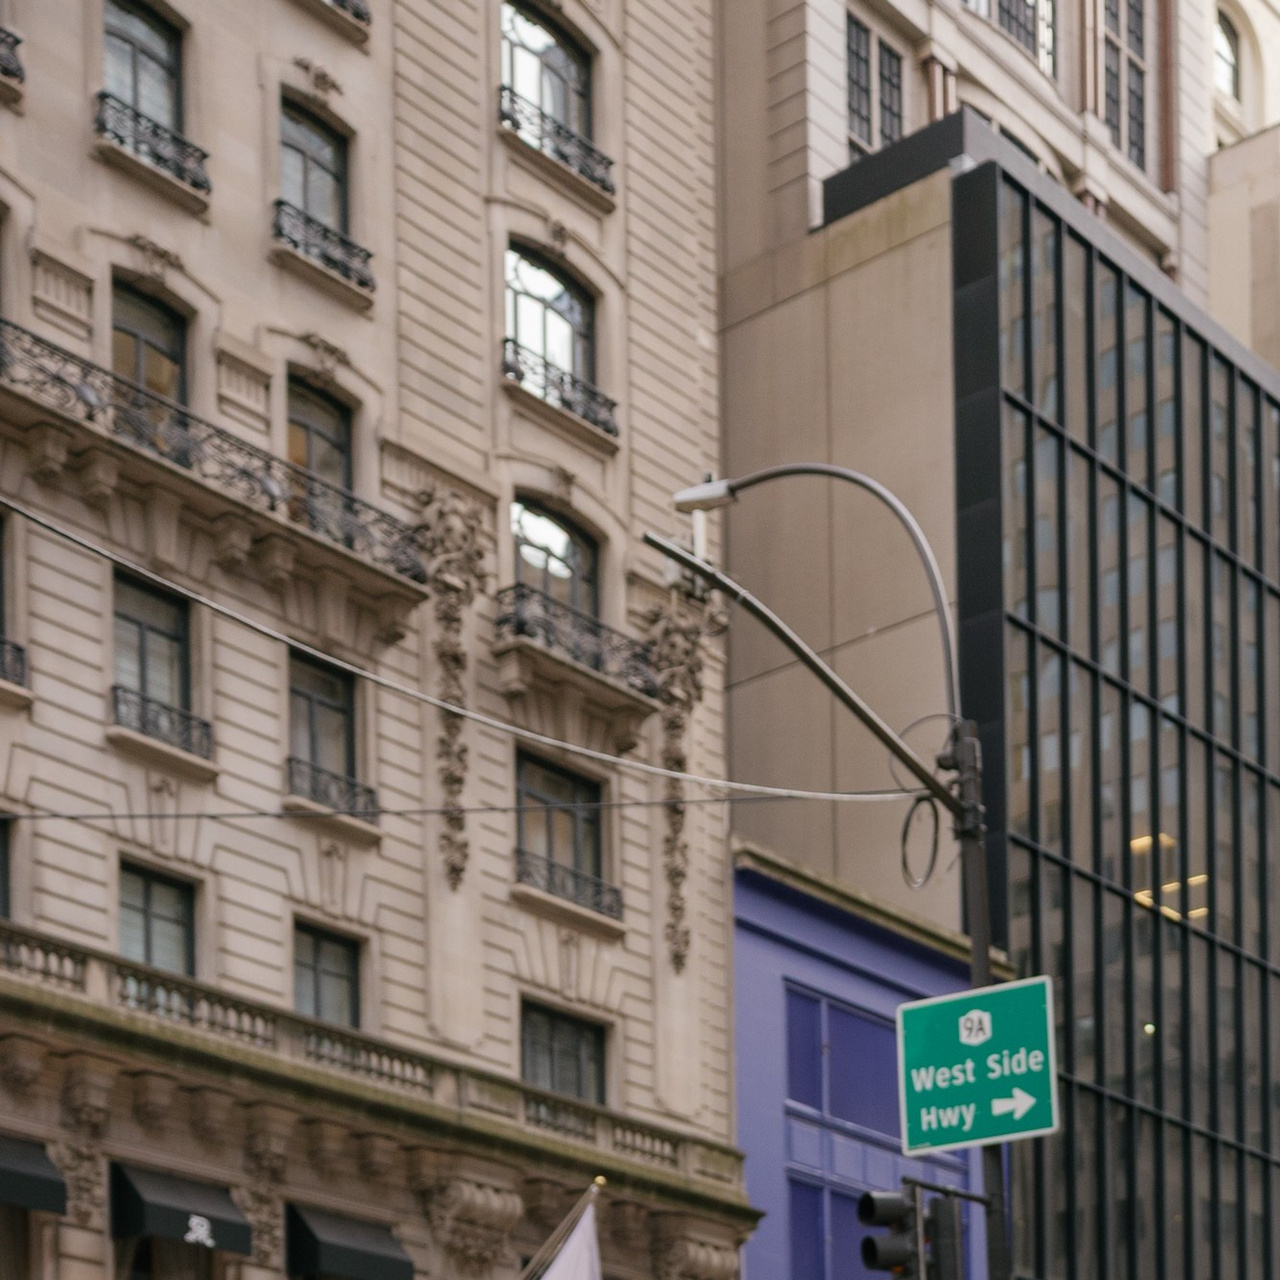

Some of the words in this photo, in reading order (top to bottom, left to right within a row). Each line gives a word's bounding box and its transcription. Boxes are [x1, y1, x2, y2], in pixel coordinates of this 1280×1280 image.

[963, 1015, 987, 1039] 9A
[911, 1058, 976, 1092] West
[986, 1047, 1045, 1080] Side
[920, 1102, 976, 1132] Hwy
